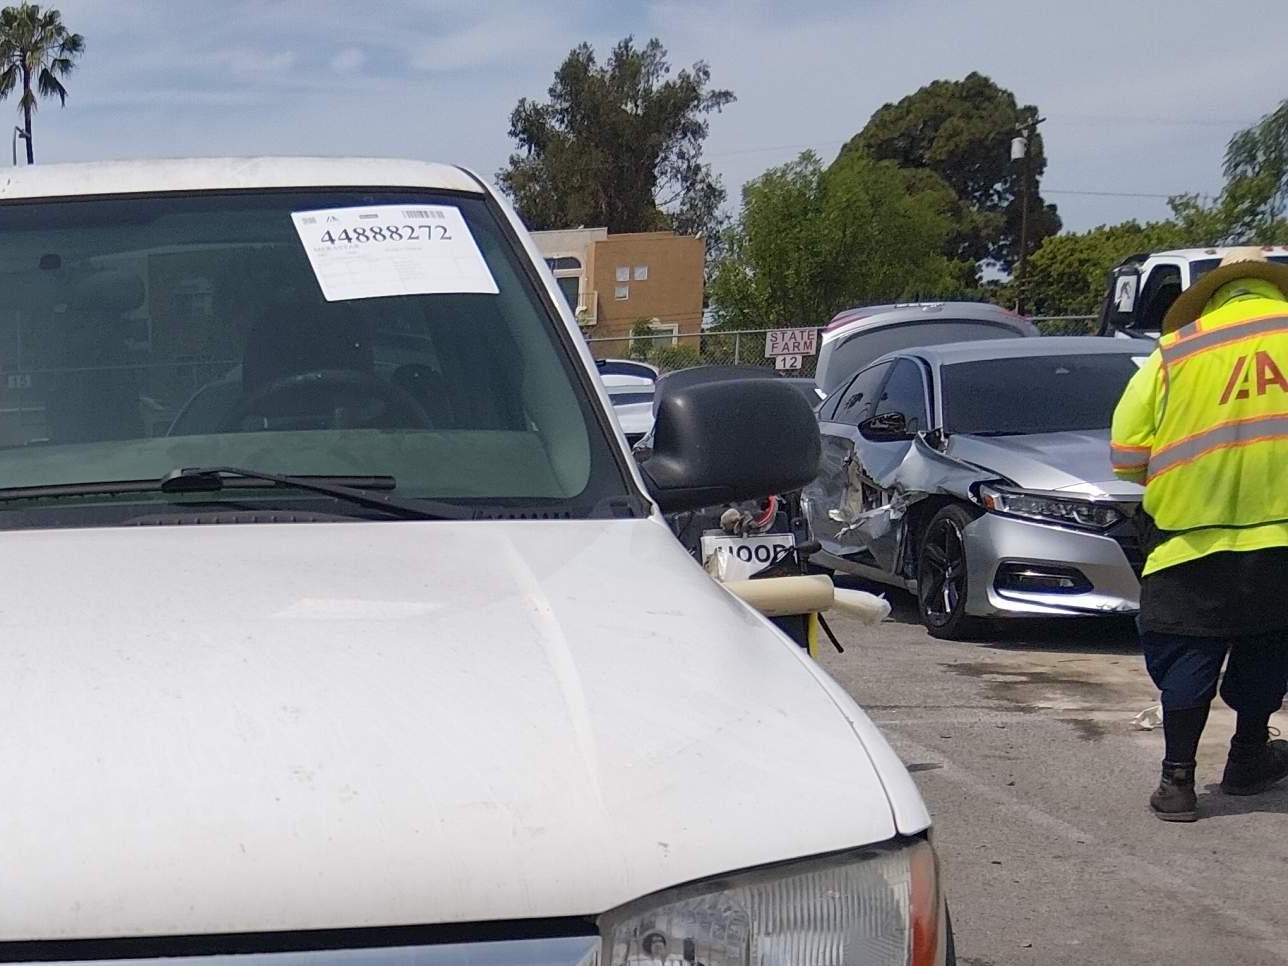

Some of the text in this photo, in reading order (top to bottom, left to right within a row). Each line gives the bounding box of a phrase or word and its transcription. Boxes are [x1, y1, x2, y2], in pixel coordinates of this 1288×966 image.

[320, 224, 452, 245] 44888272
[770, 330, 815, 343] STATE
[771, 341, 814, 353] FARM
[780, 356, 798, 369] 12
